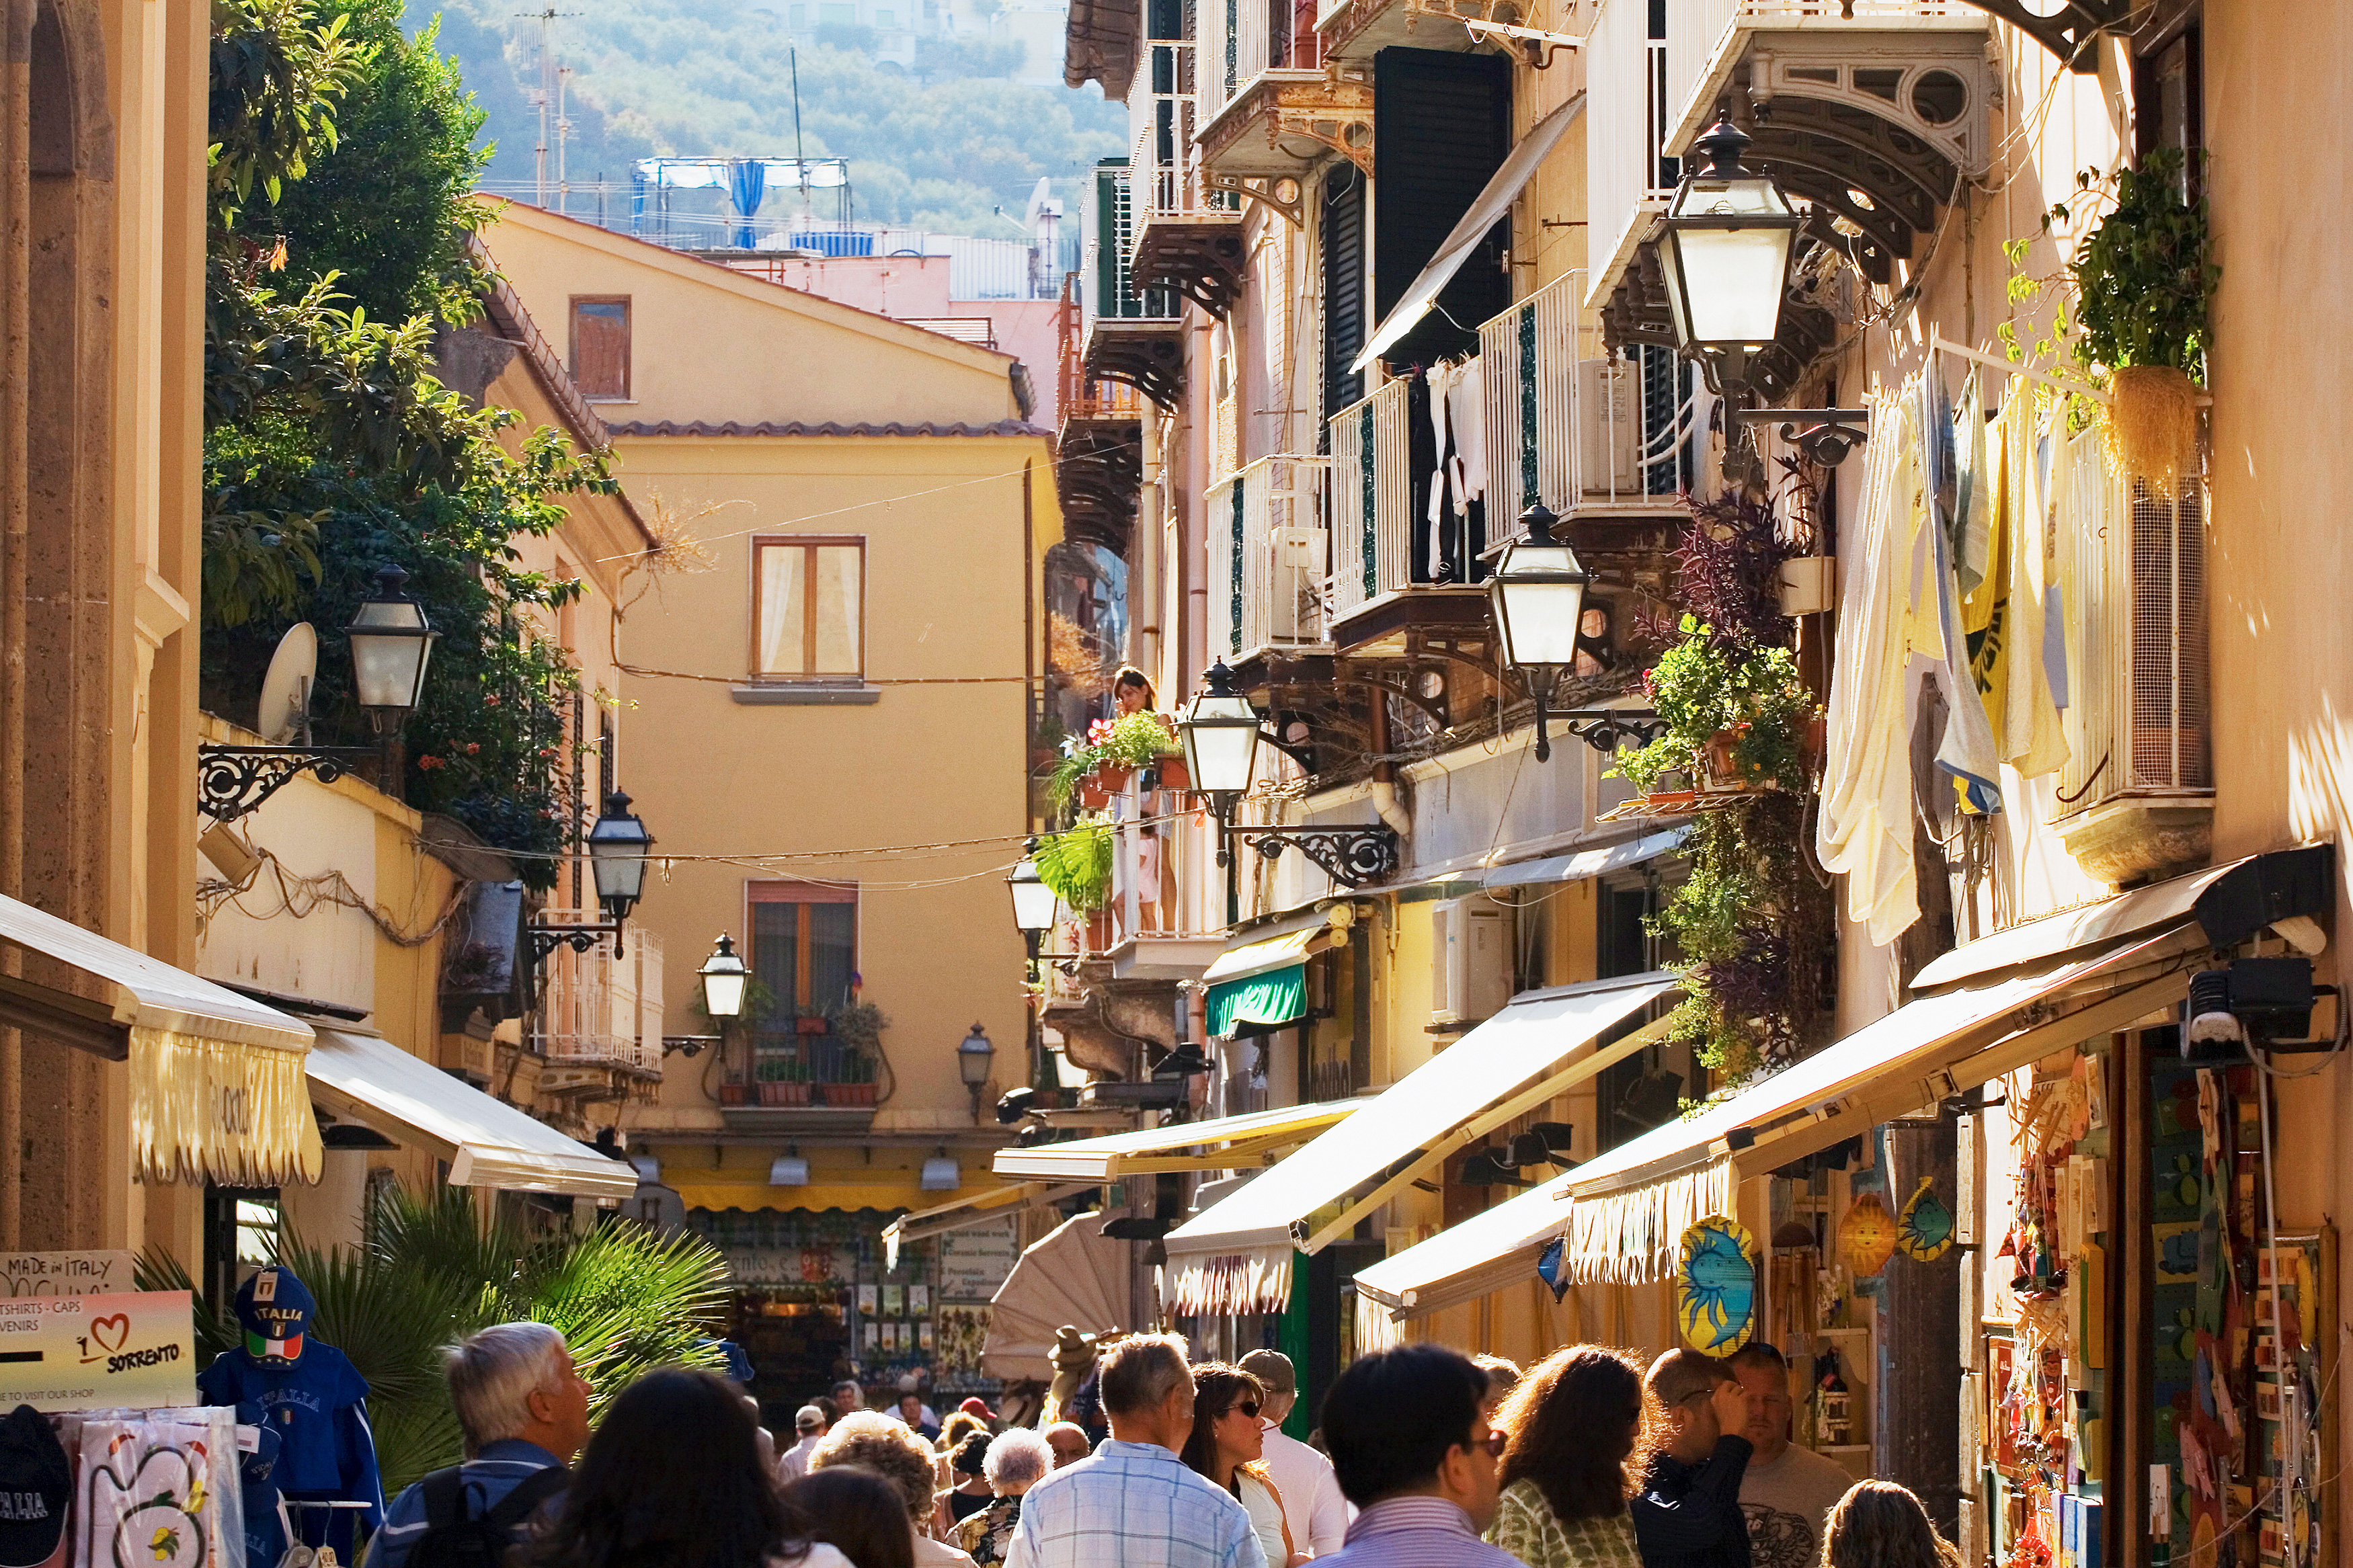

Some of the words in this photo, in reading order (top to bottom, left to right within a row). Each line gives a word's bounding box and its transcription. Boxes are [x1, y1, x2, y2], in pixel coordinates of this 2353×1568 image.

[8, 1257, 46, 1276] MADE
[52, 1301, 81, 1313] CAPS
[253, 1307, 303, 1321] ITALIA
[107, 1343, 180, 1374] SORRENTO
[8, 1392, 22, 1401] TO
[24, 1391, 44, 1400] VISIT
[48, 1389, 68, 1399] OUR
[70, 1388, 94, 1398] SHOP
[256, 1389, 320, 1412] ITALIA
